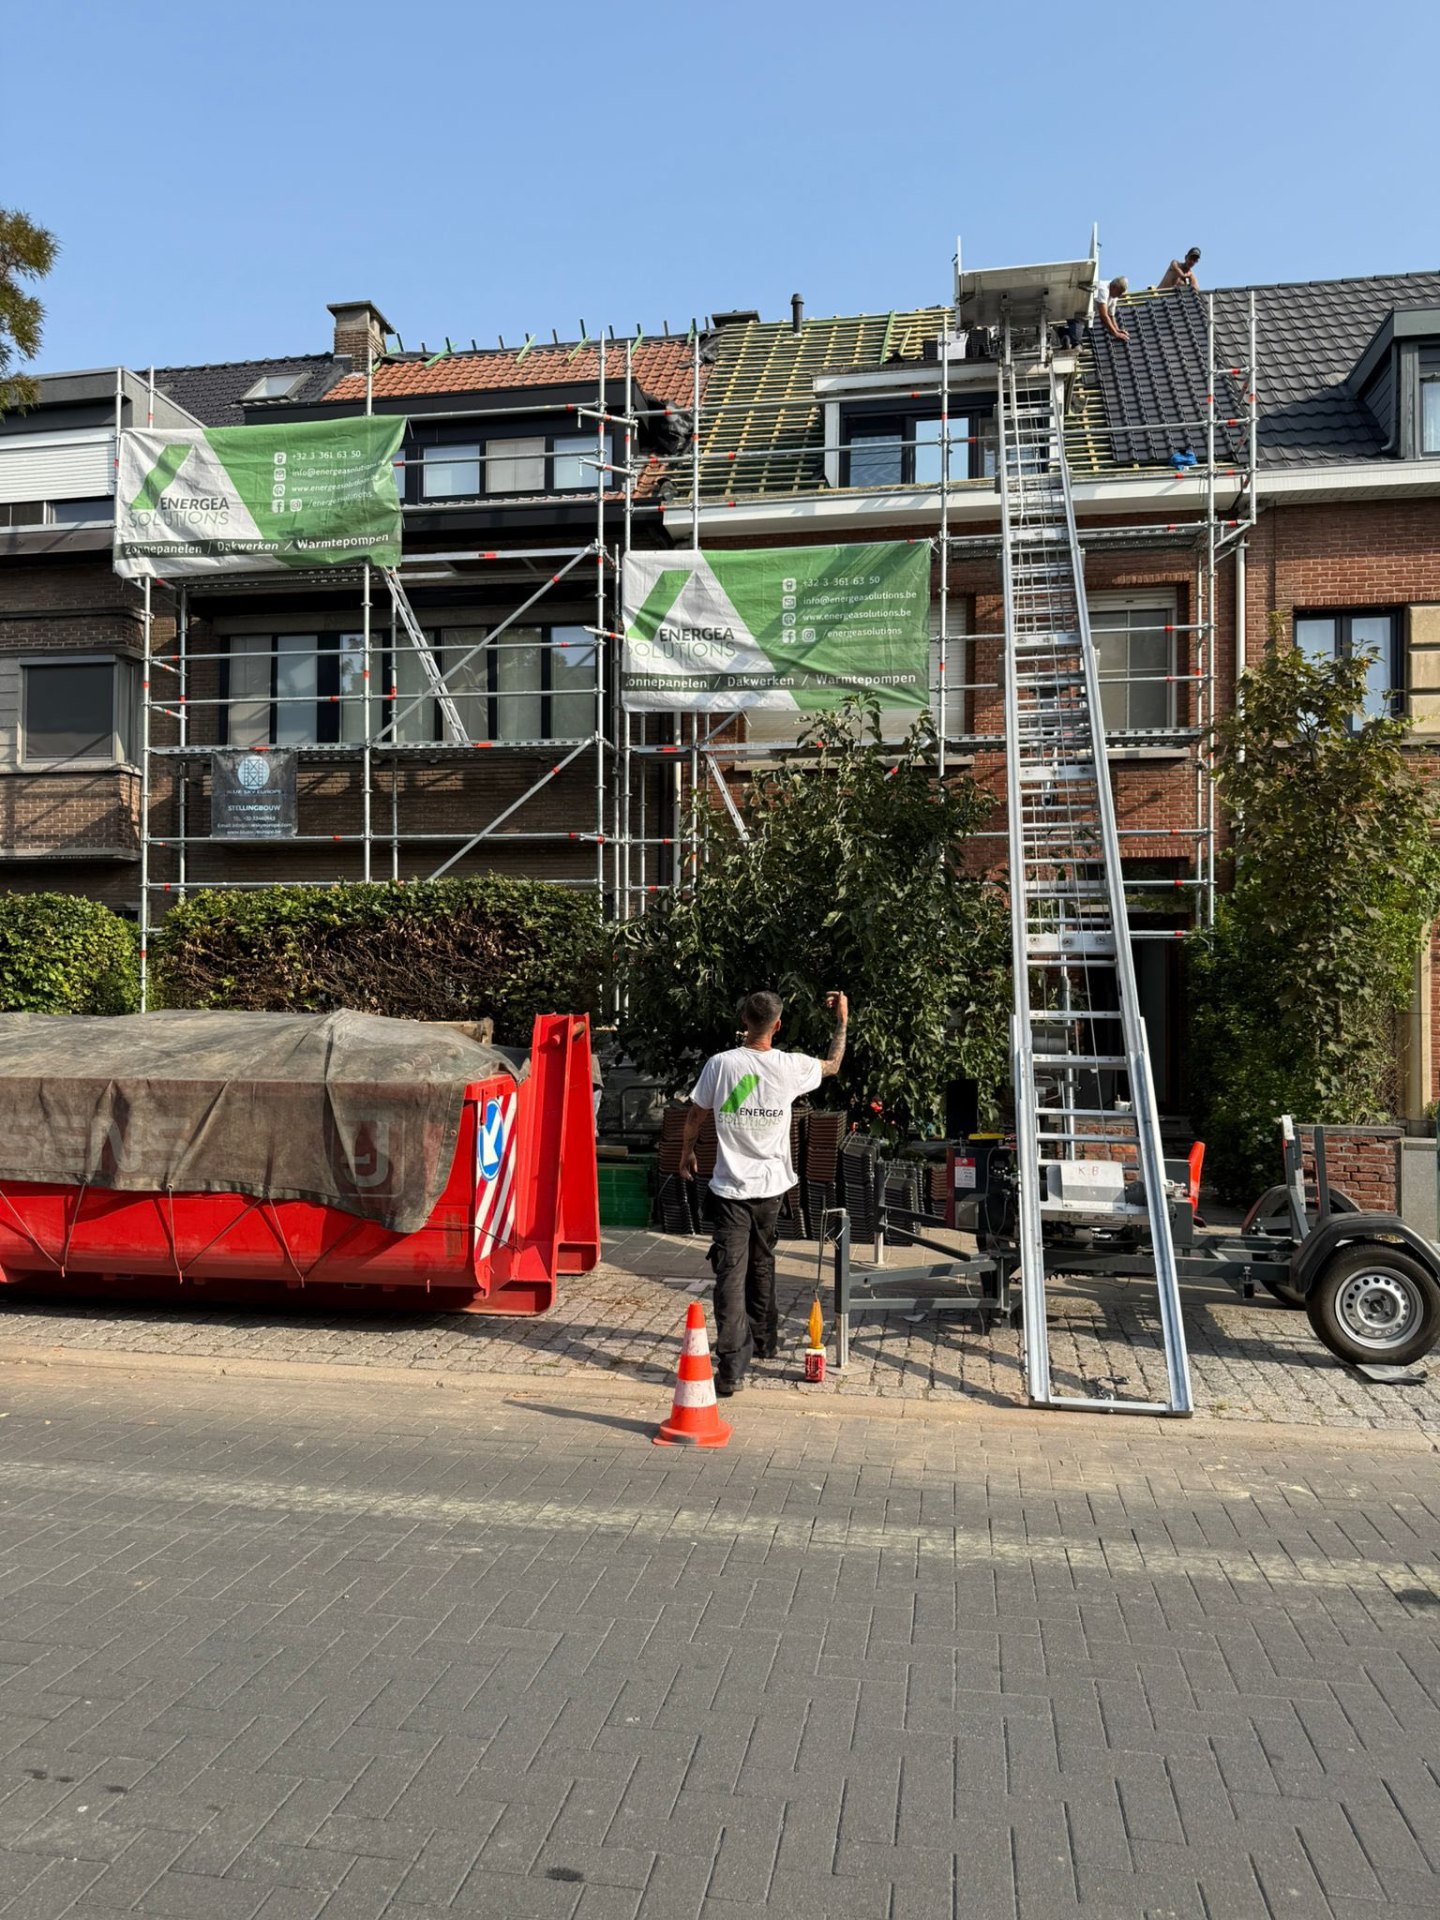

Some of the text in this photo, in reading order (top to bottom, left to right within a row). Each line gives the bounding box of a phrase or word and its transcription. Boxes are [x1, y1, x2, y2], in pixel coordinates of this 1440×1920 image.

[292, 449, 362, 461] +32 3 361 63 50
[160, 496, 230, 511] ENERGEA
[128, 510, 230, 529] SOLUTIONS
[206, 541, 213, 554] /
[217, 540, 279, 553] Dakwerken
[284, 540, 293, 552] /
[296, 532, 390, 552] Warmtepompen
[802, 575, 881, 588] +32 3 361 63 50
[803, 589, 917, 606] info@energeasolutions.be
[802, 608, 912, 622] www.energeasolutions.be
[659, 627, 735, 642] ENERGEA
[713, 676, 721, 689] /
[727, 675, 794, 687] Dakwerken
[801, 675, 809, 686] /
[816, 673, 916, 686] Warmtepompen
[227, 804, 281, 812] STELLINGBOUW
[739, 1107, 784, 1118] ENERGEA
[718, 1113, 783, 1128] SOLUTIONS
